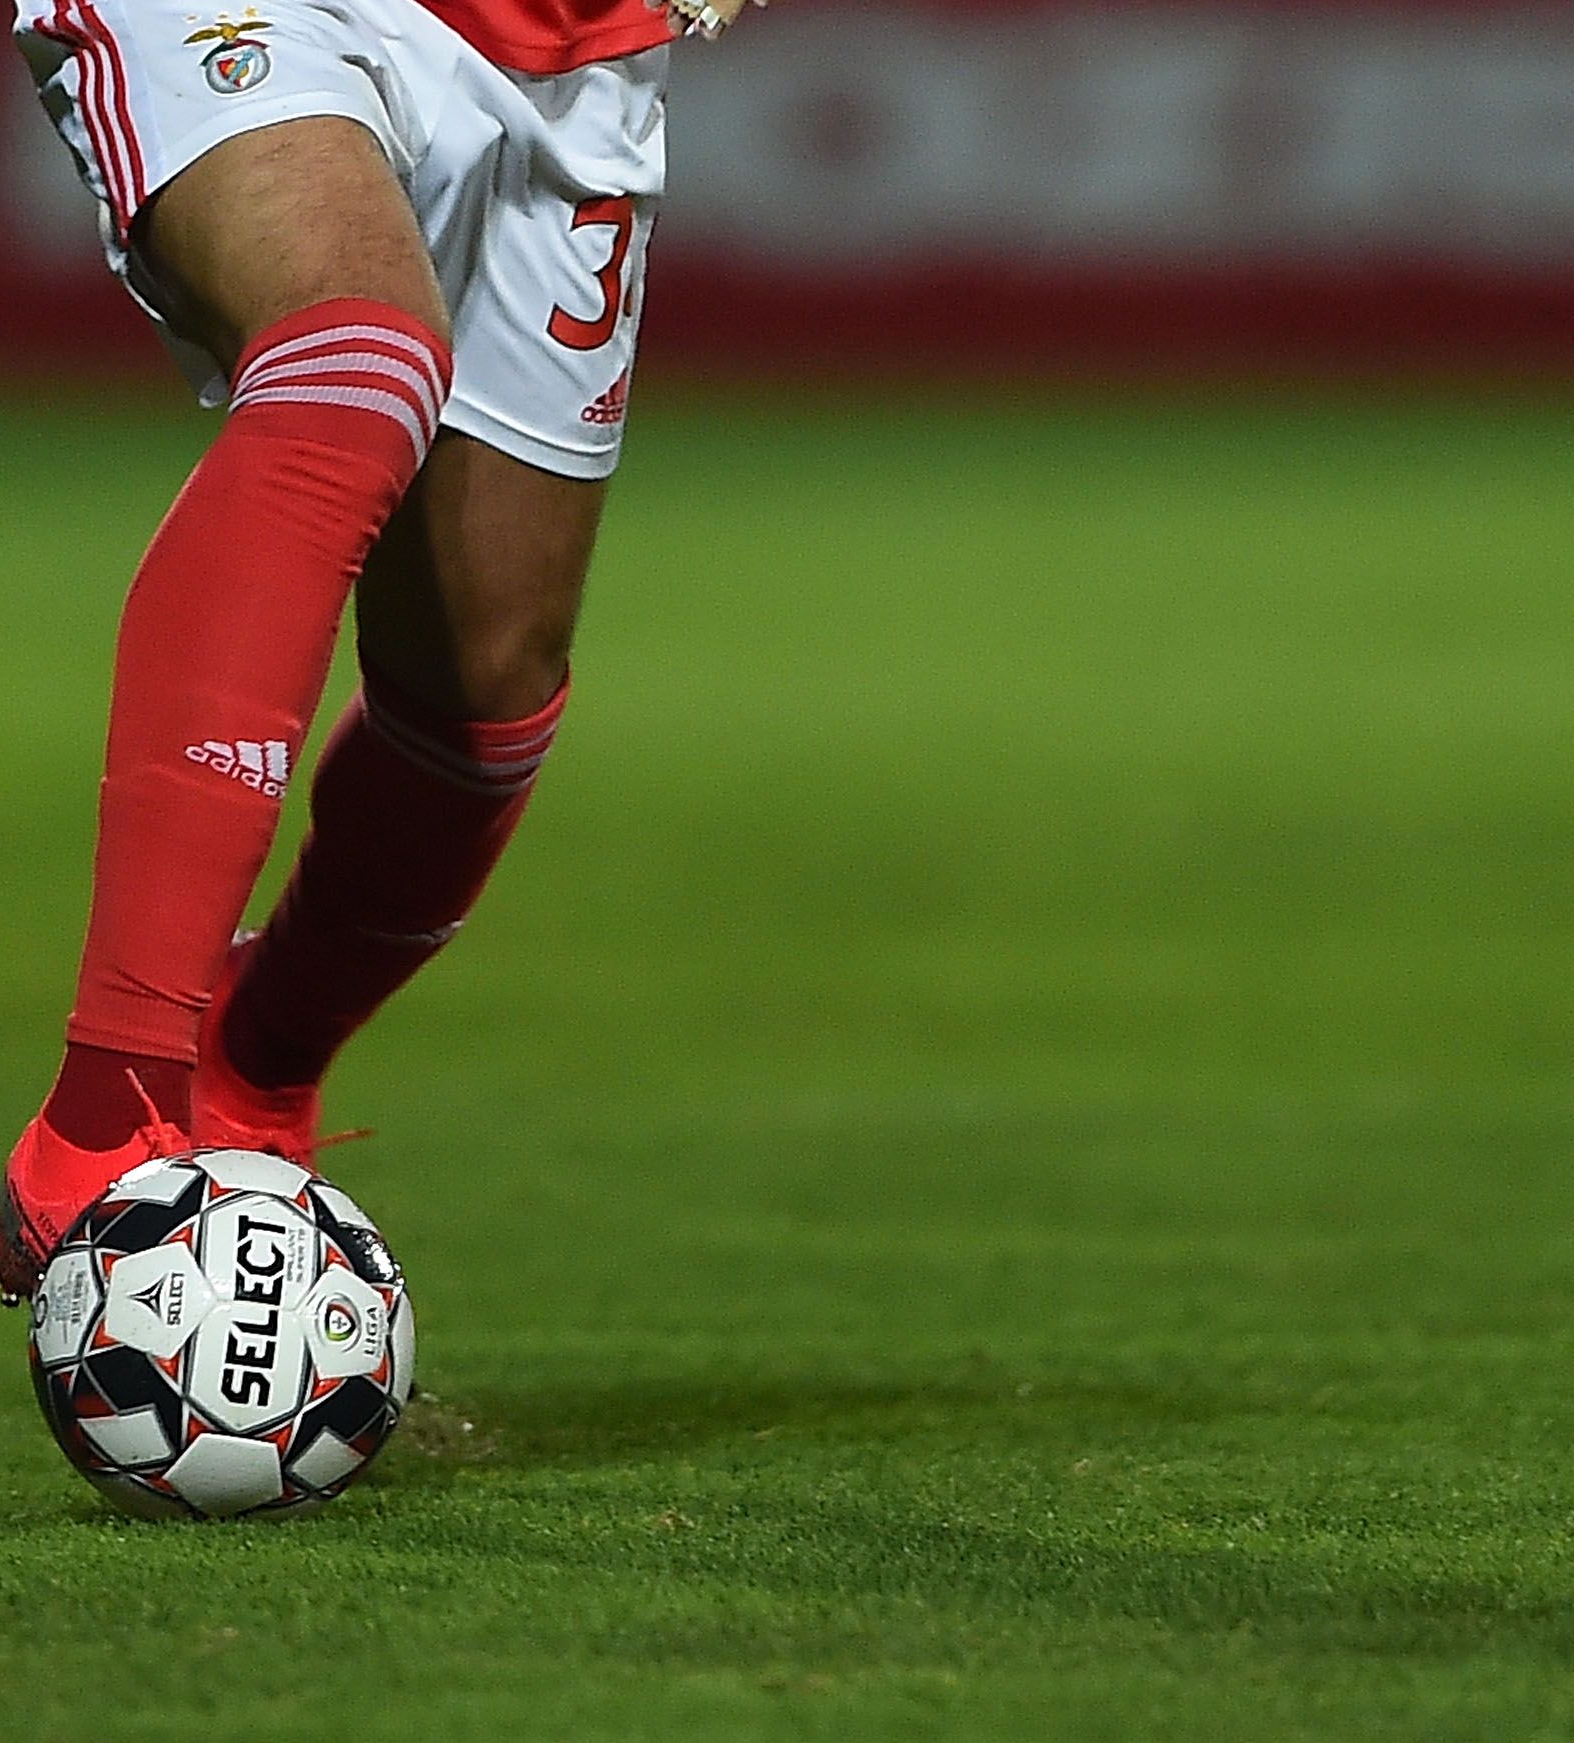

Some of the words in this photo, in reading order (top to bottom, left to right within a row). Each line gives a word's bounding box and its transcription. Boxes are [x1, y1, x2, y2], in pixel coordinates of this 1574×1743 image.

[547, 194, 634, 351] 3
[185, 746, 287, 799] adidas
[166, 1271, 185, 1327] SELECT
[222, 1215, 286, 1407] SELECT
